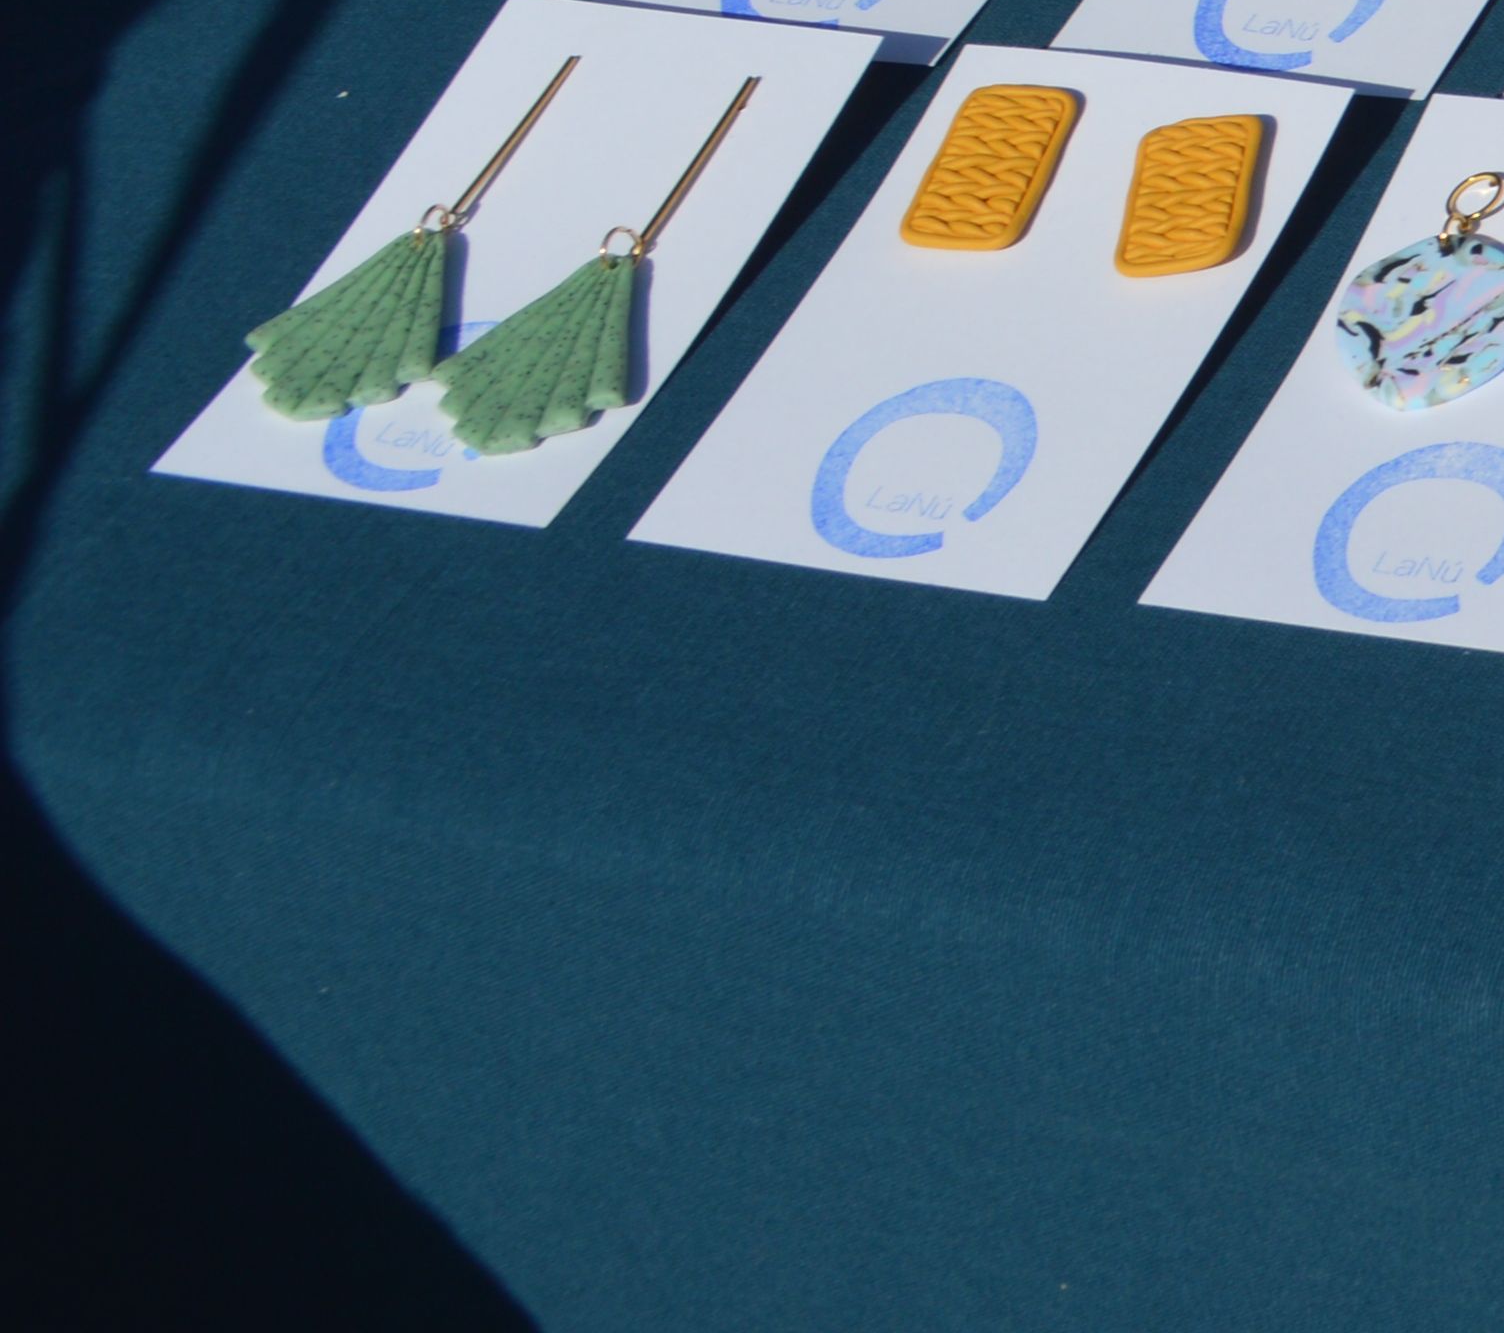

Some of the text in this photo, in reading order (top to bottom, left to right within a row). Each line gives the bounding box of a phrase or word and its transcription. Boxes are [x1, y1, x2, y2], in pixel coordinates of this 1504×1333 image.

[1243, 14, 1319, 41] LaNú
[375, 422, 455, 456] LaNú
[866, 487, 953, 520] LaNú
[1373, 552, 1462, 583] LaNú
